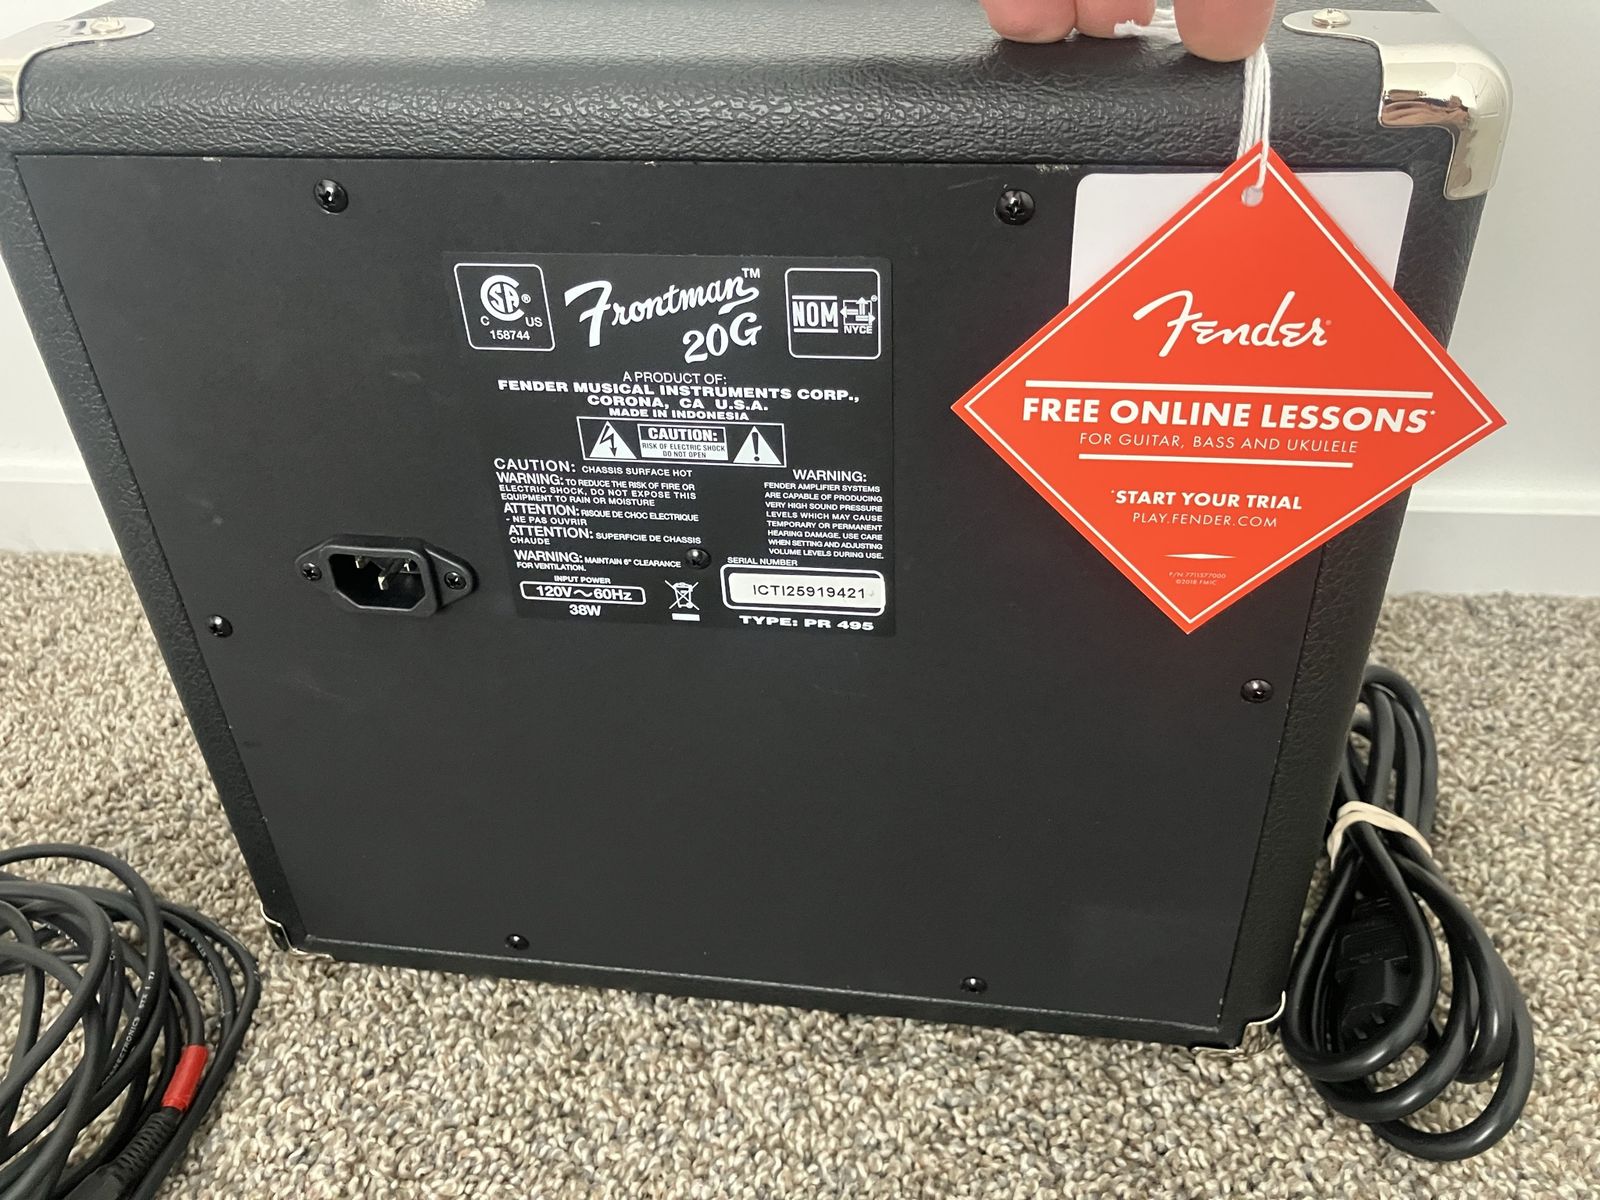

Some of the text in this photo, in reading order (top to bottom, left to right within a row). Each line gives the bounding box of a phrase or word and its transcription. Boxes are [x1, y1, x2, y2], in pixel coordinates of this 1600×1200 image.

[792, 301, 839, 327] NOM
[480, 316, 543, 327] C US
[1132, 290, 1327, 357] Fender
[490, 330, 530, 340] 158744
[844, 325, 872, 334] NYCE
[683, 312, 762, 363] 20G
[623, 371, 727, 384] A PRODUCT OF:
[498, 380, 860, 402] FENDER MUSICAL INSTRUMENTS CORP.,
[587, 396, 768, 409] CORONA, CA U.S.A.
[609, 408, 750, 420] MADE IN INDONESIA
[1022, 398, 1100, 423] FREE
[1110, 400, 1251, 428] ONLINE
[648, 428, 718, 442] CAUTION:
[1080, 432, 1358, 454] FOR GUITAR, BASS AND UKULELE
[494, 458, 575, 472] CAUTION:
[582, 466, 692, 477] CHASSIS SURFACE HOT
[793, 469, 867, 482] WARNING:
[496, 472, 564, 485] WARNING:
[578, 479, 610, 487] REDUCE
[611, 480, 627, 488] THE
[628, 481, 647, 489] RISK
[661, 482, 680, 490] FIRE
[682, 483, 695, 491] OR
[764, 482, 796, 490] FENDER
[798, 483, 840, 491] AMPLIFIER
[499, 485, 547, 493] ELECTRIC
[549, 486, 587, 496] SHOCK,
[591, 488, 604, 496] DO
[632, 490, 671, 498] EXPOSE
[673, 491, 696, 499] THIS
[834, 494, 882, 502] PRODUCING
[501, 493, 552, 502] EQUIPMENT
[554, 495, 567, 503] TO
[569, 496, 591, 504] RAIN
[609, 497, 655, 506] MOISTURE
[1182, 492, 1239, 508] YOUR
[1246, 494, 1302, 510] TRIAL
[504, 503, 580, 516] ATTENTION:
[840, 504, 882, 512] PRESSURE
[512, 516, 526, 524] NE
[529, 516, 547, 524] PAS
[550, 517, 587, 526] OUVRIR
[581, 510, 699, 522] RISQUE DE CHOC ELECTRIQUE
[766, 511, 797, 519] LEVELS
[800, 512, 830, 520] WHICH
[1133, 512, 1277, 527] PLAY.FENDER.COM
[767, 520, 816, 529] TEMPORARY
[832, 523, 882, 531] PERMANENT
[509, 525, 593, 539] ATTENTION:
[596, 532, 647, 542] SUPERFICIE
[663, 535, 701, 544] CHASSIS
[768, 530, 802, 538] HEARING
[805, 531, 841, 539] DAMAGE.
[510, 537, 550, 545] CHAUDE
[792, 540, 822, 548] SETTING
[841, 542, 882, 550] ADJUSTING
[514, 550, 583, 563] WARNING:
[769, 548, 801, 556] VOLUME
[517, 562, 586, 572] FOR VENTILATION.
[585, 557, 623, 565] MAINTAIN
[633, 559, 681, 568] CLEARANCE
[727, 557, 798, 567] SERIAL NUMBER
[554, 575, 611, 584] INPUT POWER
[569, 604, 601, 617] 38W
[739, 615, 874, 631] TYPE: PR 495
